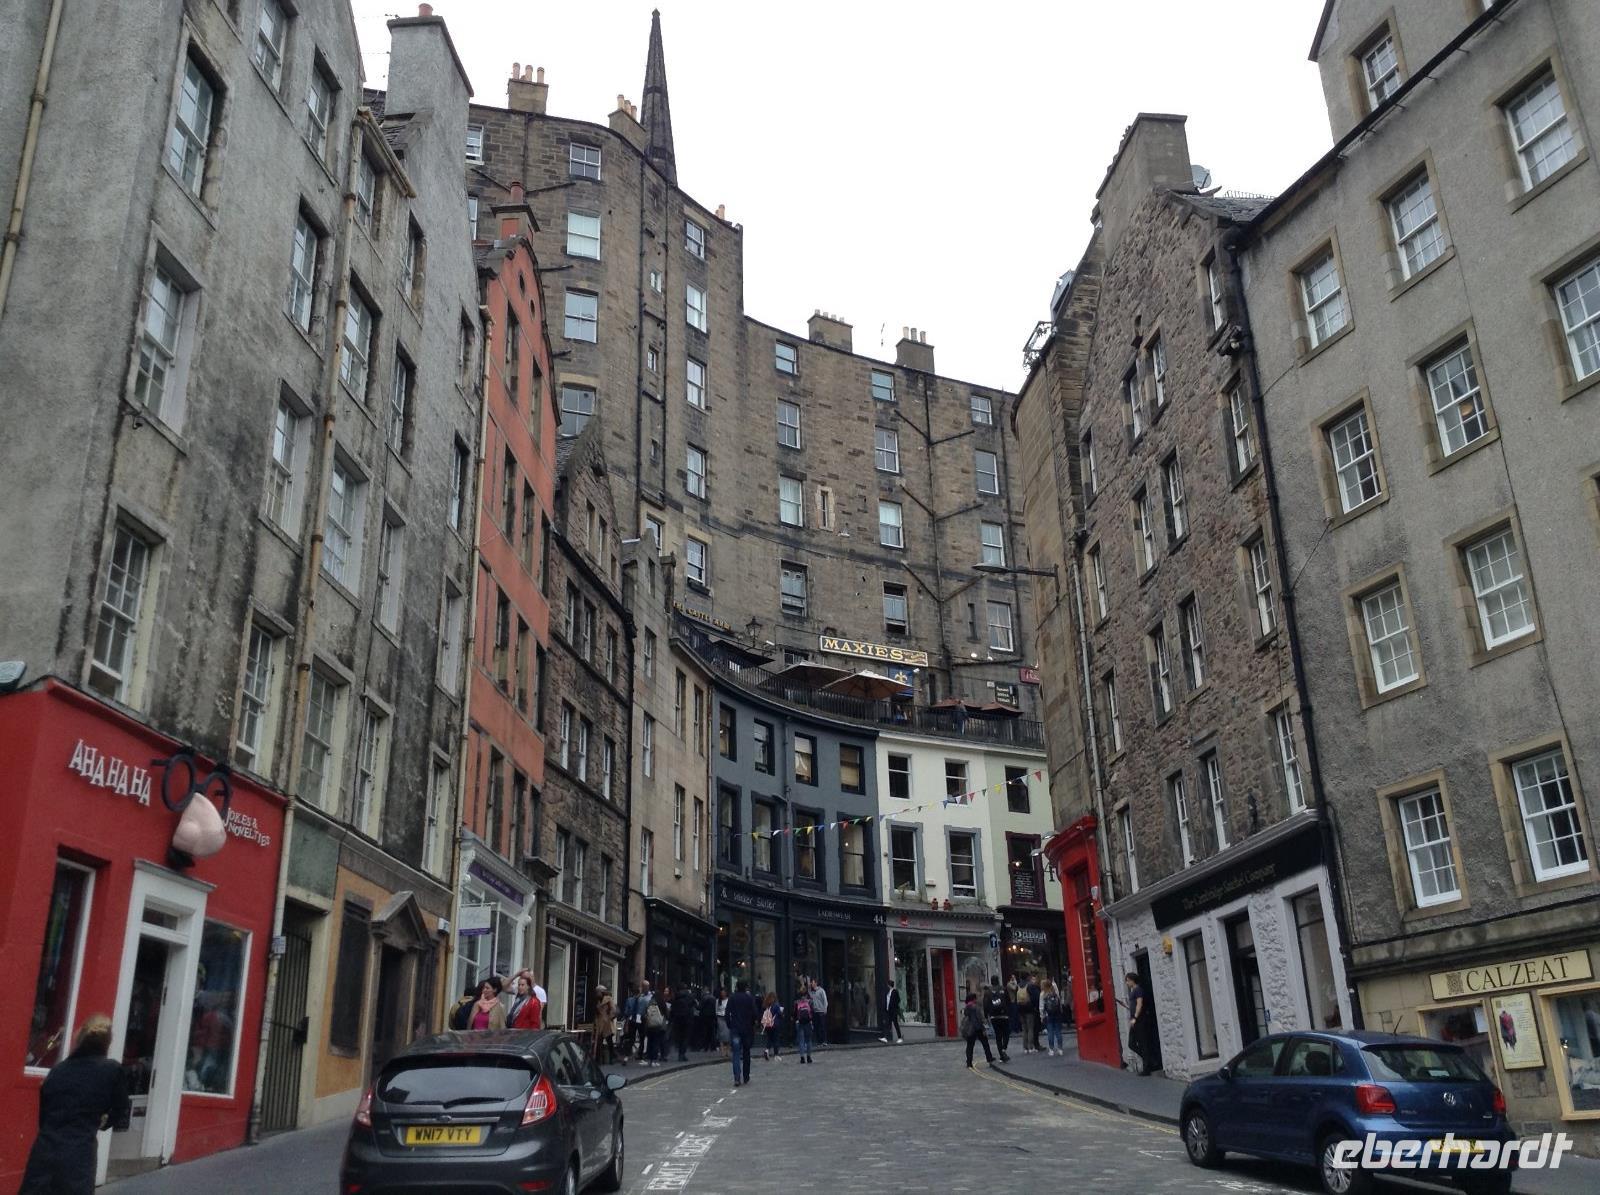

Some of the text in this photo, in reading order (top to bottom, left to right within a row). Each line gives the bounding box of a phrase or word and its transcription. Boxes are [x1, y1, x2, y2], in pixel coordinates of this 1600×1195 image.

[824, 638, 904, 660] MAXIES
[224, 807, 252, 827] JOKES
[226, 823, 271, 847] NOVELTIES
[1466, 956, 1569, 992] CALZEAT
[415, 1128, 472, 1141] WN17 VTY
